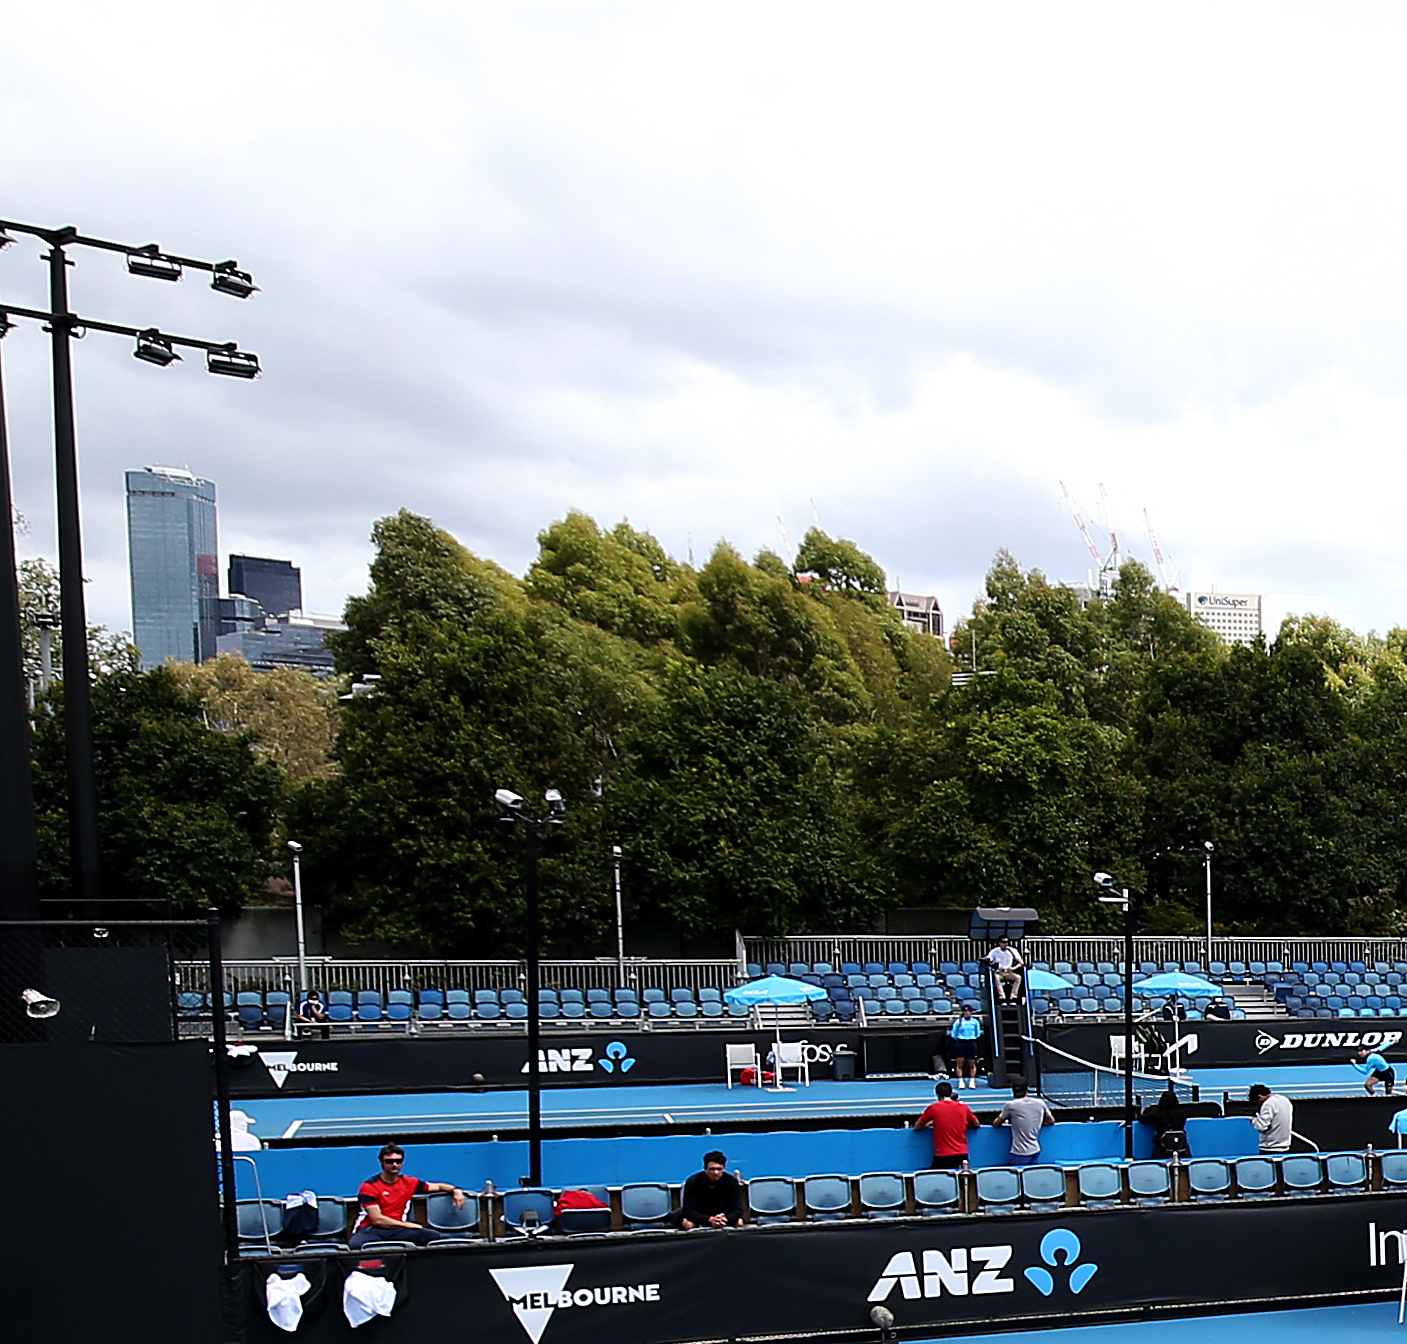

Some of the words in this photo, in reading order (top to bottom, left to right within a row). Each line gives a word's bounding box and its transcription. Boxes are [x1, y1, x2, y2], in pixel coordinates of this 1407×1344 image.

[1279, 1031, 1403, 1048] DUNLOP
[867, 1245, 1015, 1302] ANZ
[508, 1283, 661, 1311] MELBOURNE
